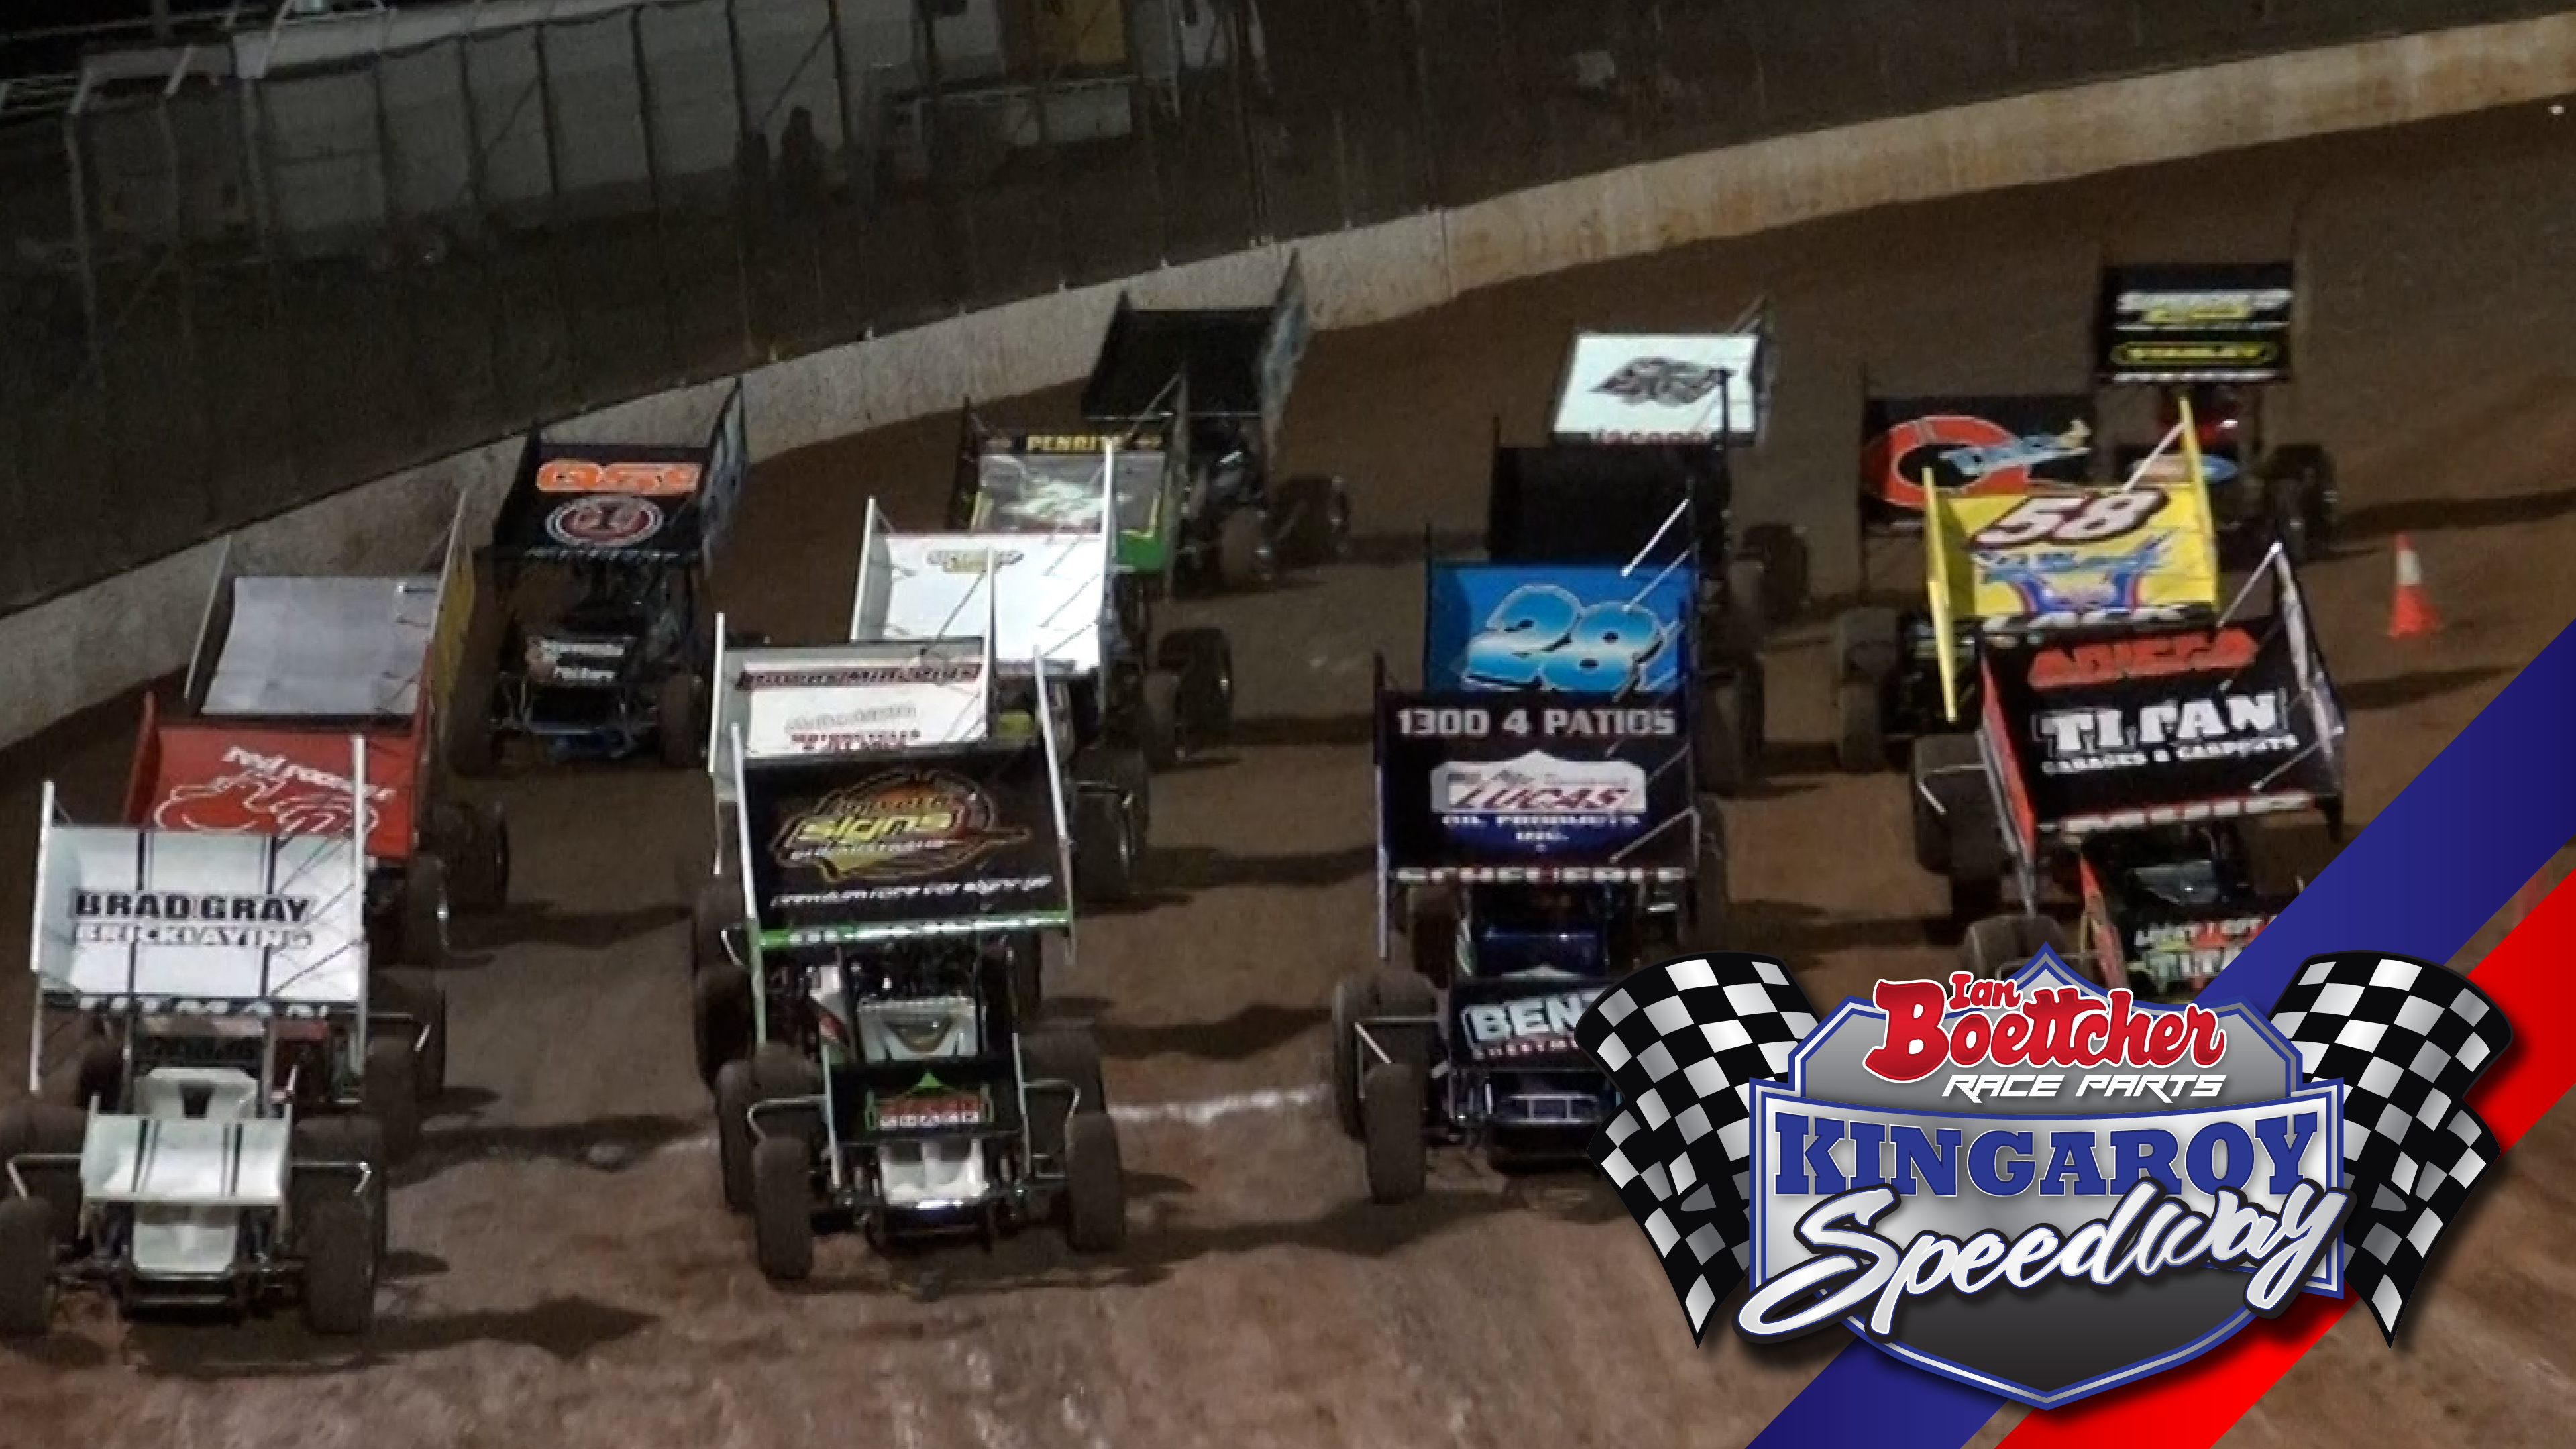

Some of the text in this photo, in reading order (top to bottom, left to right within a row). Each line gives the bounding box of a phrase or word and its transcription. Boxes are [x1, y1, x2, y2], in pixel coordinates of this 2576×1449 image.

[1974, 488, 2169, 547] 58
[1462, 583, 1664, 691] 28
[1397, 708, 1676, 736] 1300 4 PATIOS
[2040, 691, 2278, 751] TITAN
[74, 892, 311, 922] BRAD GRAY
